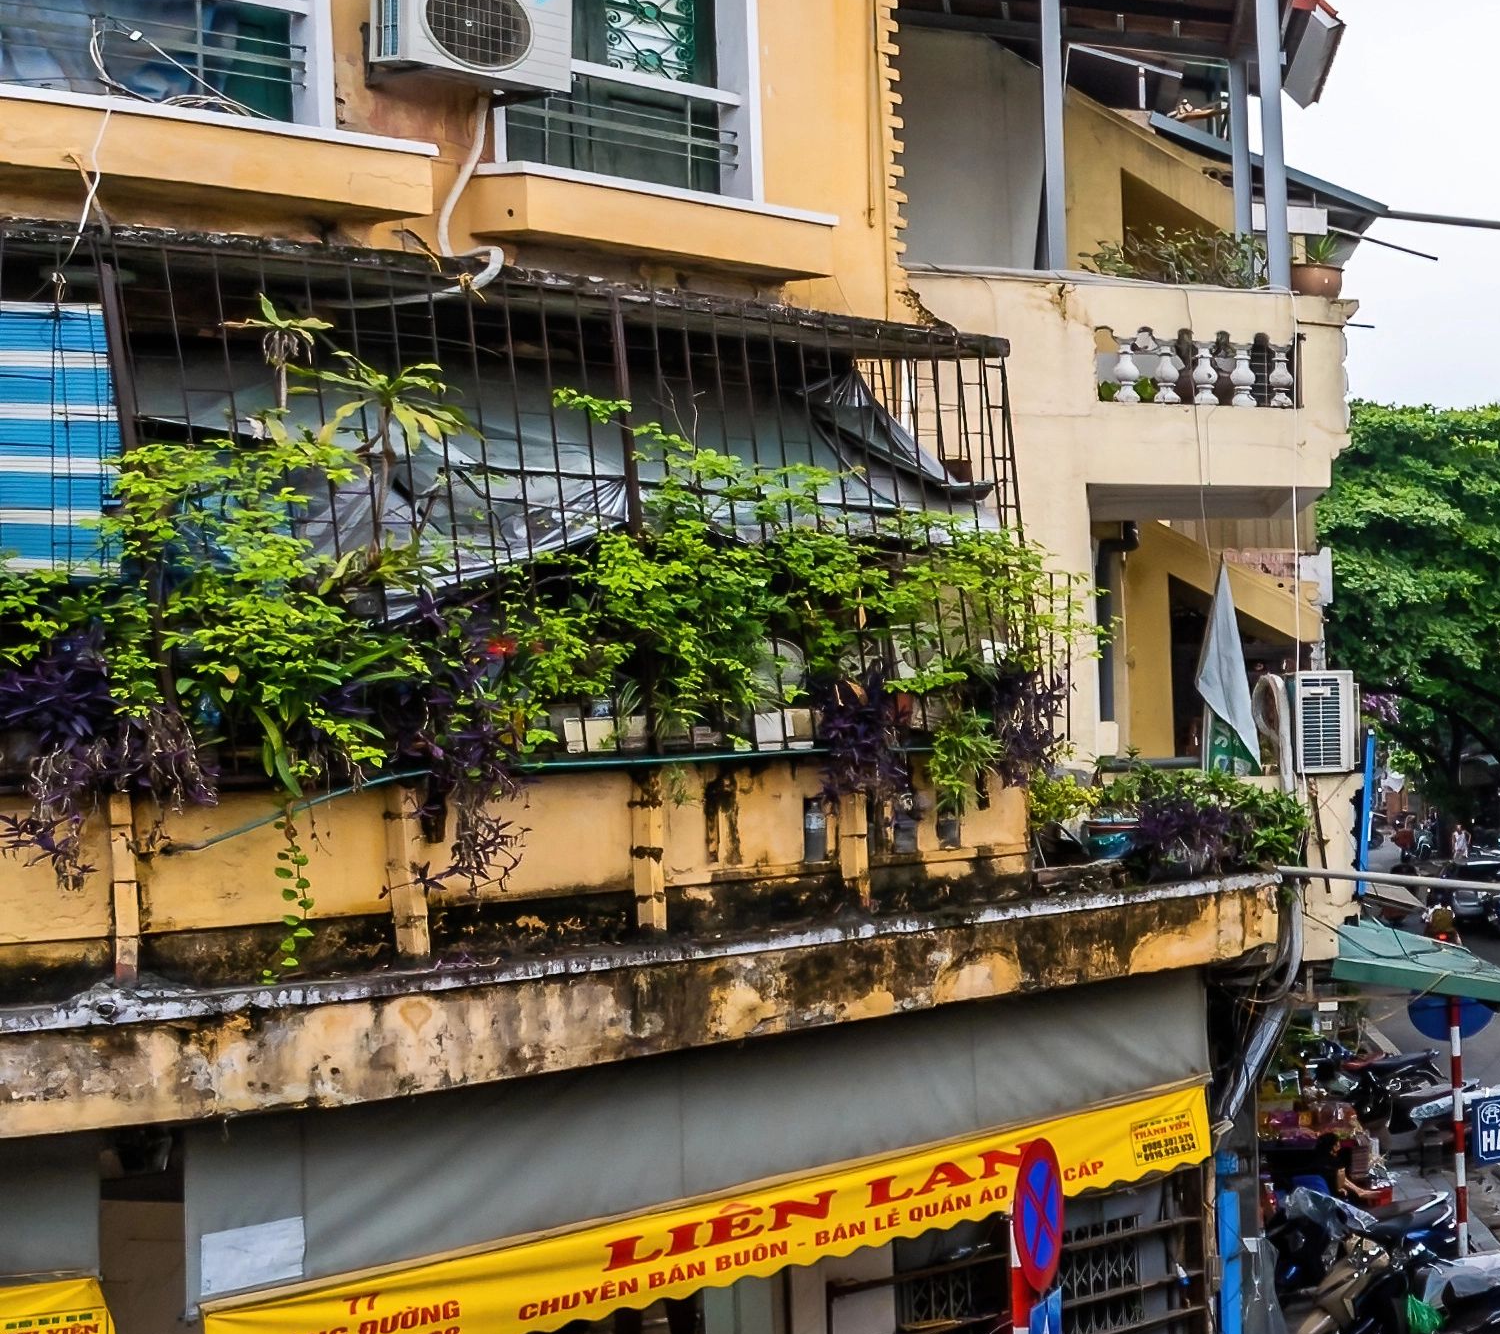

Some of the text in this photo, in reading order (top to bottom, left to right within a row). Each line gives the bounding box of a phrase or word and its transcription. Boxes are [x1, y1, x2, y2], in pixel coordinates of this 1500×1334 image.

[518, 1276, 639, 1320] CHUYÊN
[648, 1260, 706, 1289] BÁN
[716, 1240, 788, 1273] BUÔN
[815, 1220, 866, 1246] BÁN
[875, 1207, 901, 1231] LẺ
[979, 1184, 1009, 1205] ÁO
[602, 1140, 1033, 1273] LIÊN LAN
[343, 1291, 381, 1315] 77
